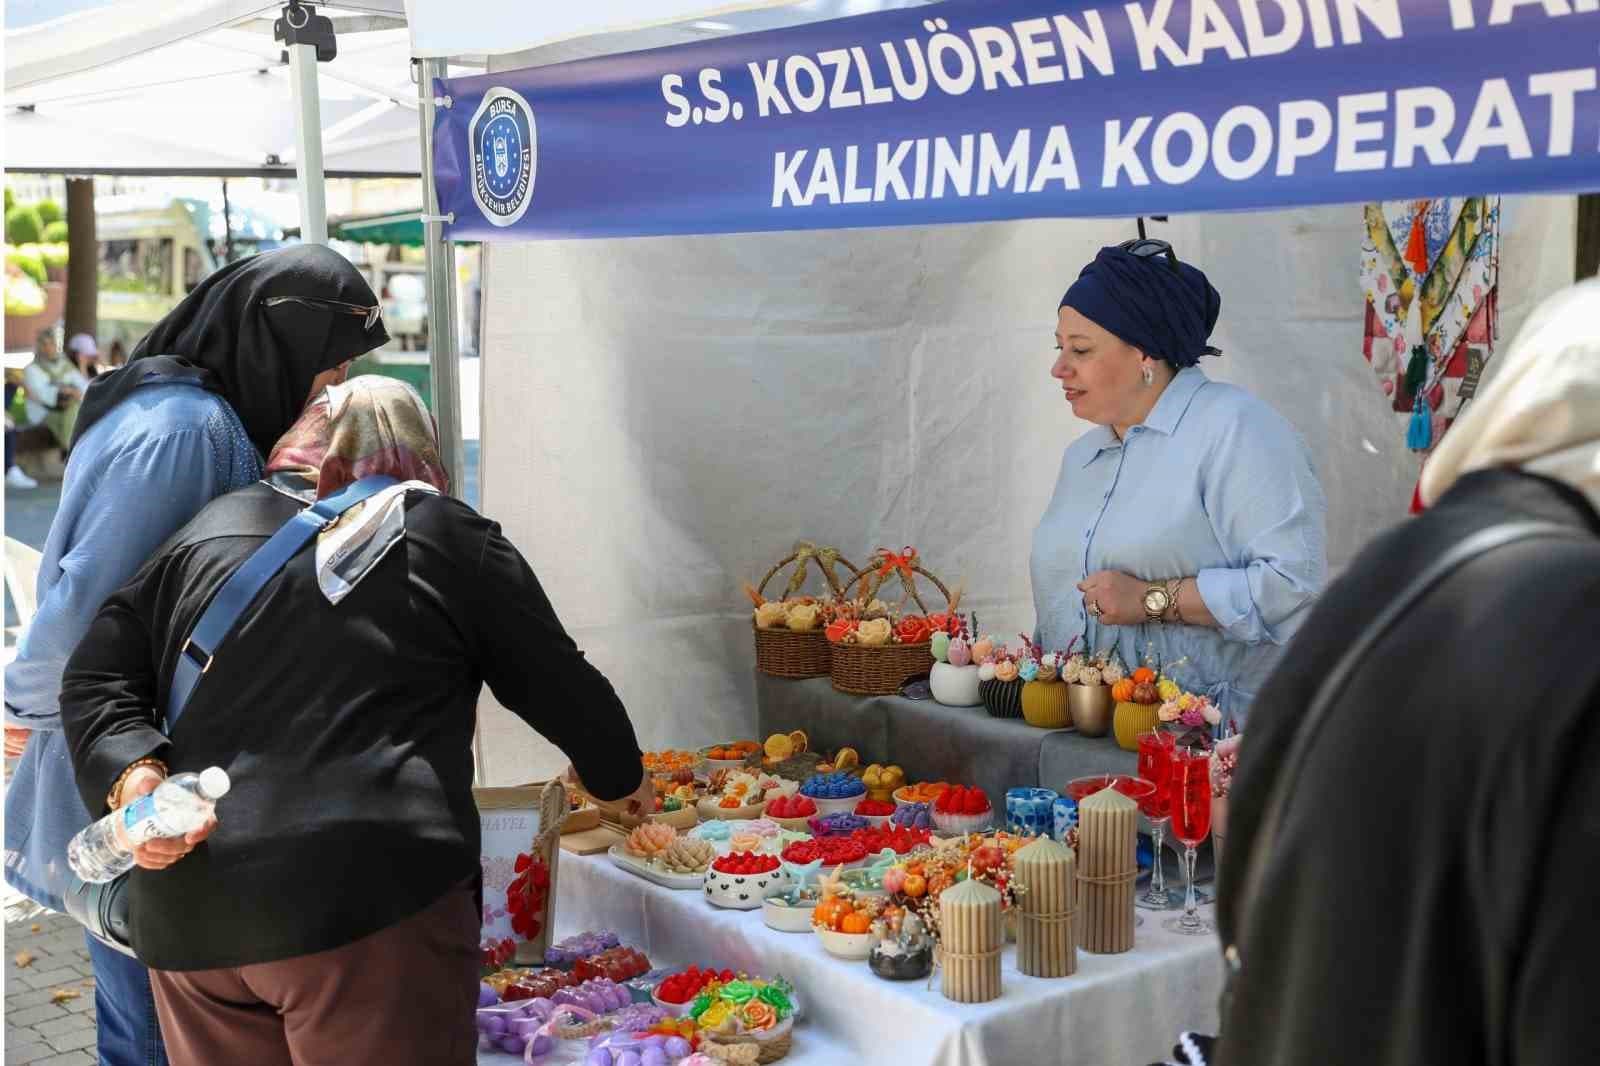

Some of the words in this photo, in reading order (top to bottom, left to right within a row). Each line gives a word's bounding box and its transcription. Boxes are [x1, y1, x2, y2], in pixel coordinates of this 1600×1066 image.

[489, 100, 517, 119] BURSA
[661, 73, 744, 128] S.S.
[746, 9, 1115, 117] KOZLUÖREN
[1123, 0, 1404, 71] KADIN
[771, 125, 1081, 208] KALKINMA
[1102, 67, 1600, 188] KOOPERAT
